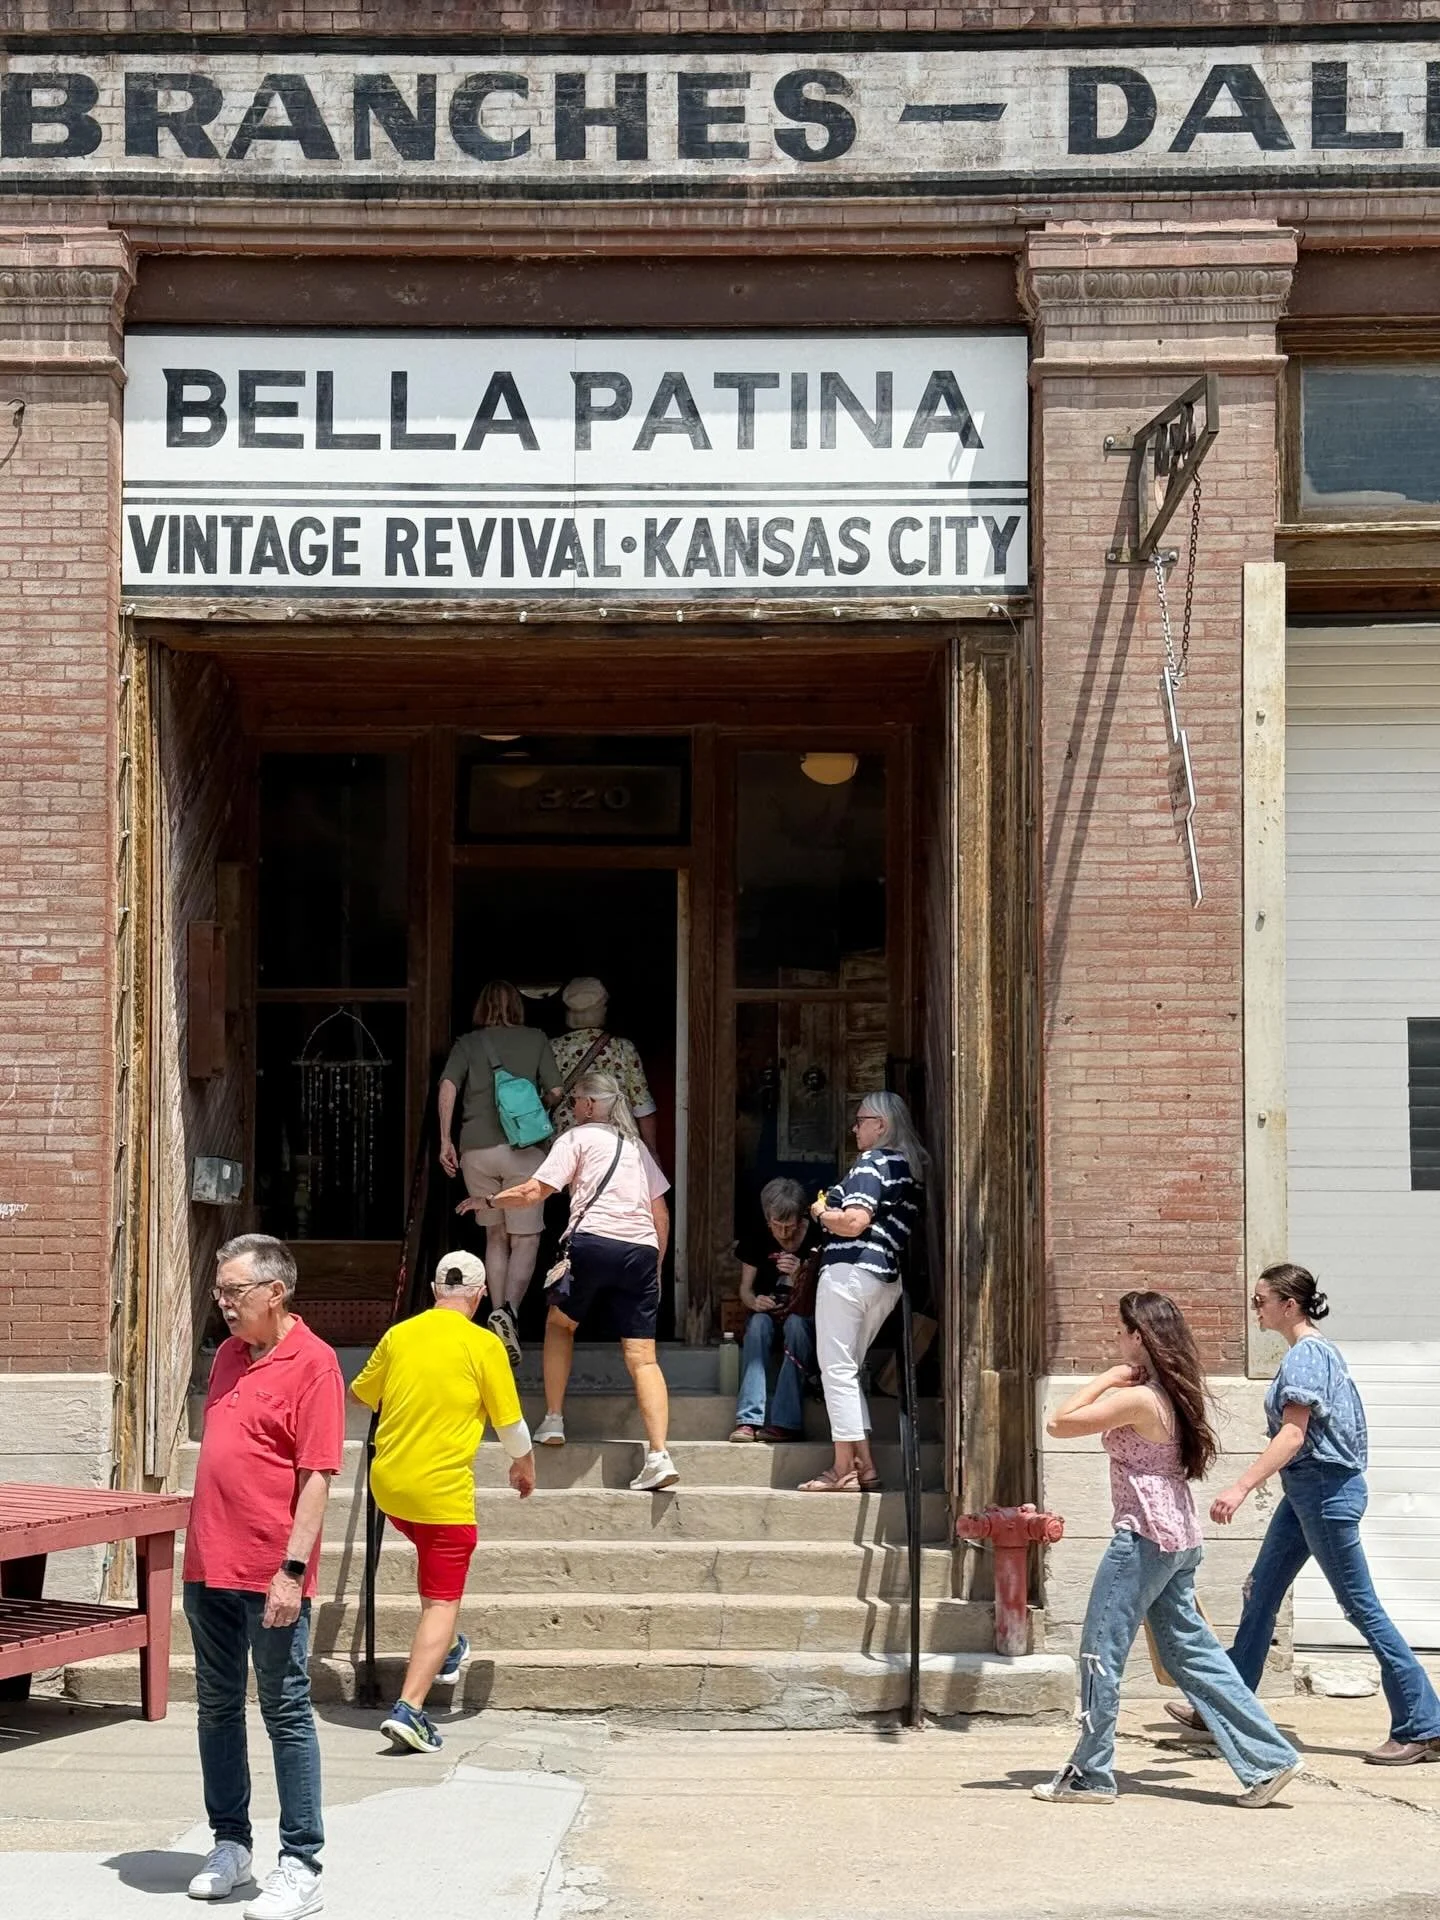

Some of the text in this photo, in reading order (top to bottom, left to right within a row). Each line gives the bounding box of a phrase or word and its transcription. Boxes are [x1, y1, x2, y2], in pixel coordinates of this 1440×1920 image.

[0, 70, 858, 163] BRANCHES
[1067, 62, 1440, 154] DAL
[162, 368, 984, 451] BELLA PATINA
[128, 514, 361, 576] VINTAGE
[888, 516, 1021, 576] CITY
[538, 786, 631, 810] 320
